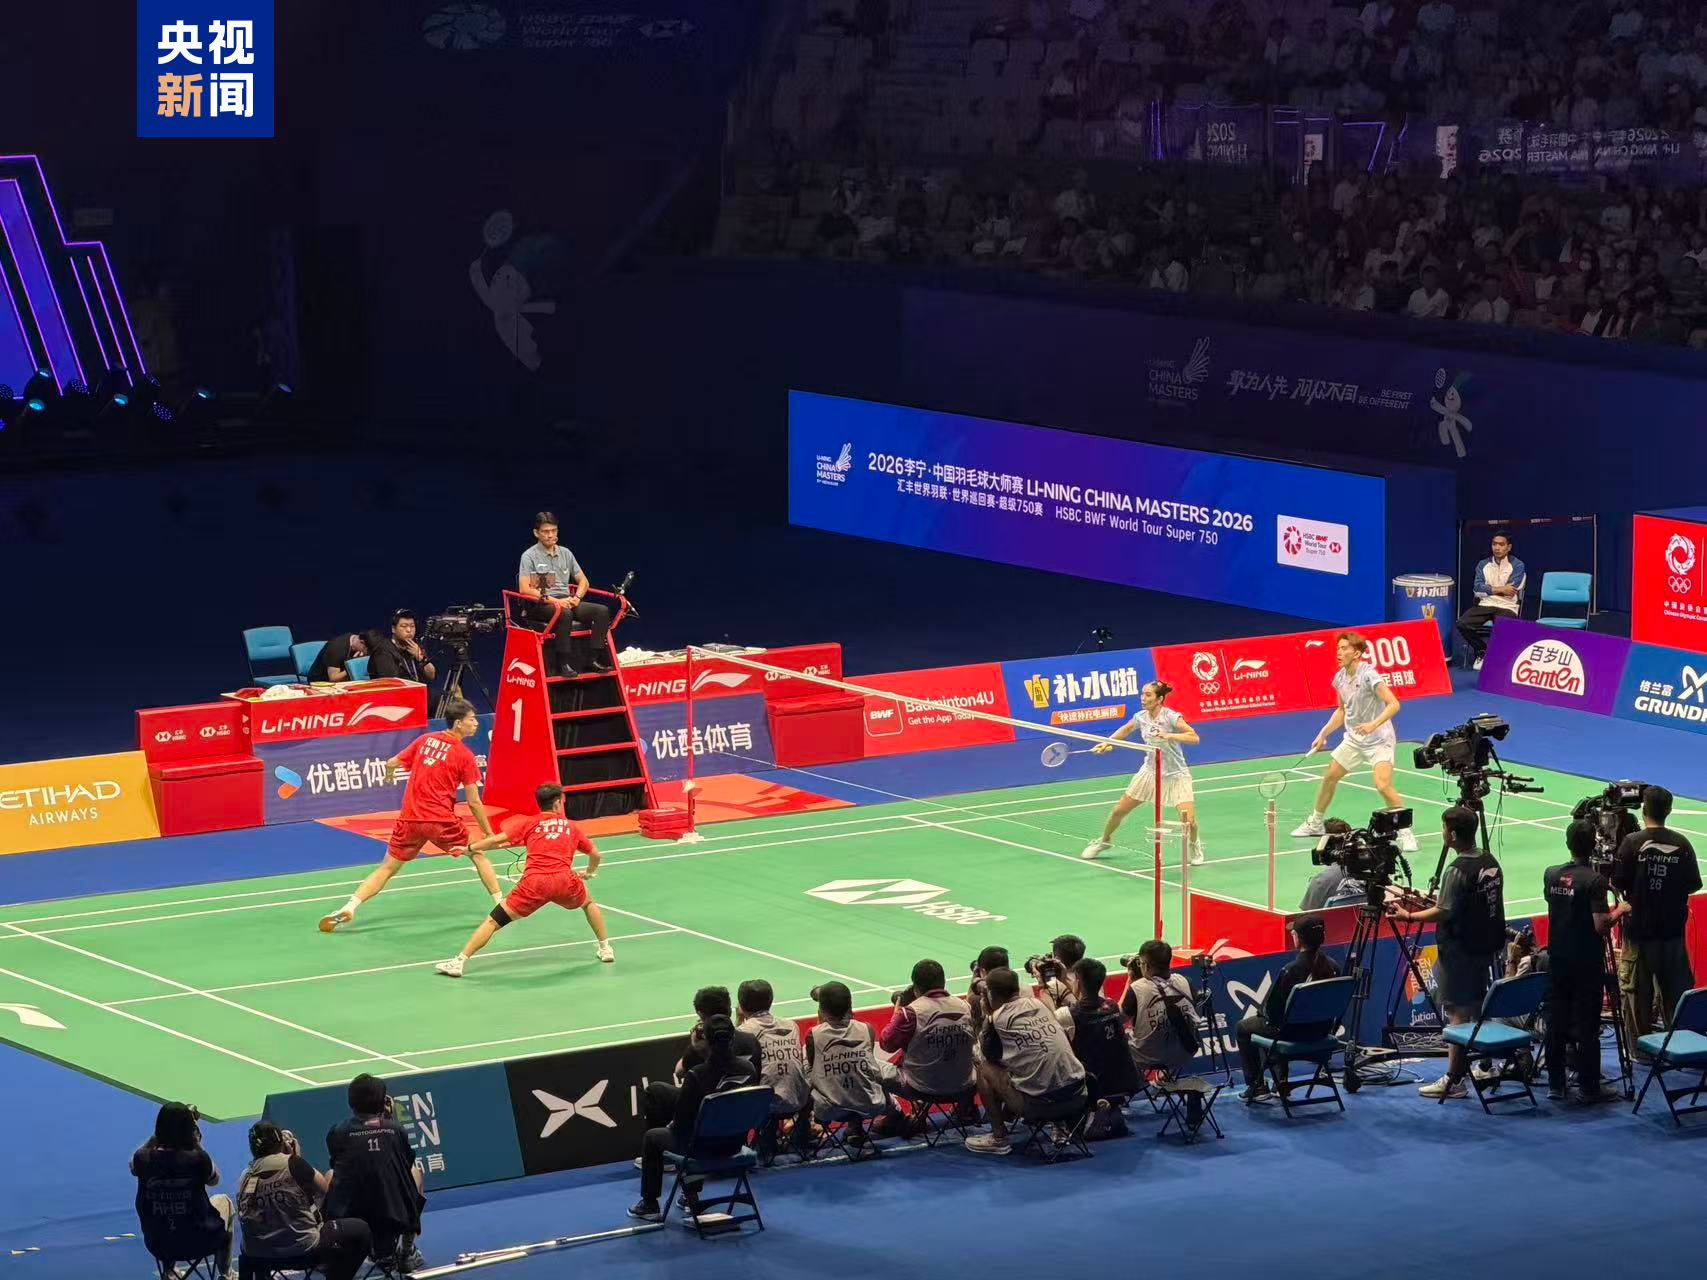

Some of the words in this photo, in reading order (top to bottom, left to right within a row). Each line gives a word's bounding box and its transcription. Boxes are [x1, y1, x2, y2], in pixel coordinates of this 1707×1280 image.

[1149, 370, 1184, 384] CHINA
[1149, 383, 1199, 400] MASTERS
[816, 462, 836, 472] CHINA
[816, 470, 846, 482] MASTERS
[1027, 479, 1081, 503] LI-NING
[1084, 488, 1133, 512] CHINA
[1136, 497, 1209, 525] MASTERS
[1212, 509, 1253, 532] 2026
[1055, 505, 1082, 522] HSBC
[1084, 510, 1106, 526] BWF
[1109, 514, 1138, 532] World
[1141, 520, 1163, 536] Tour
[1166, 525, 1196, 543] Super
[1198, 529, 1218, 545] 750
[1529, 645, 1573, 666] 百岁山
[506, 674, 536, 688] LI-NING
[1233, 669, 1270, 681] LI-NING
[1380, 670, 1417, 687] 定用球
[1516, 659, 1580, 693] Ganten
[625, 679, 687, 696] I-NING
[1053, 667, 1138, 703] 补水啦
[1639, 679, 1674, 697] 格兰富
[512, 698, 523, 742] 1
[870, 708, 894, 720] BWF
[908, 717, 922, 725] Get
[922, 715, 935, 724] the
[936, 714, 952, 724] App
[261, 713, 345, 734] LI-NING
[652, 722, 753, 760] 优酷体育
[0, 780, 121, 810] ETIHAD
[29, 807, 98, 826] AIRWAYS
[1550, 886, 1575, 897] MEDIA
[1015, 1024, 1057, 1051] PHOTO
[760, 1048, 800, 1062] PHOTO
[823, 1051, 867, 1062] LI-NING
[777, 1063, 788, 1076] 51
[824, 1060, 868, 1077] PHOTO
[367, 1138, 381, 1152] 11
